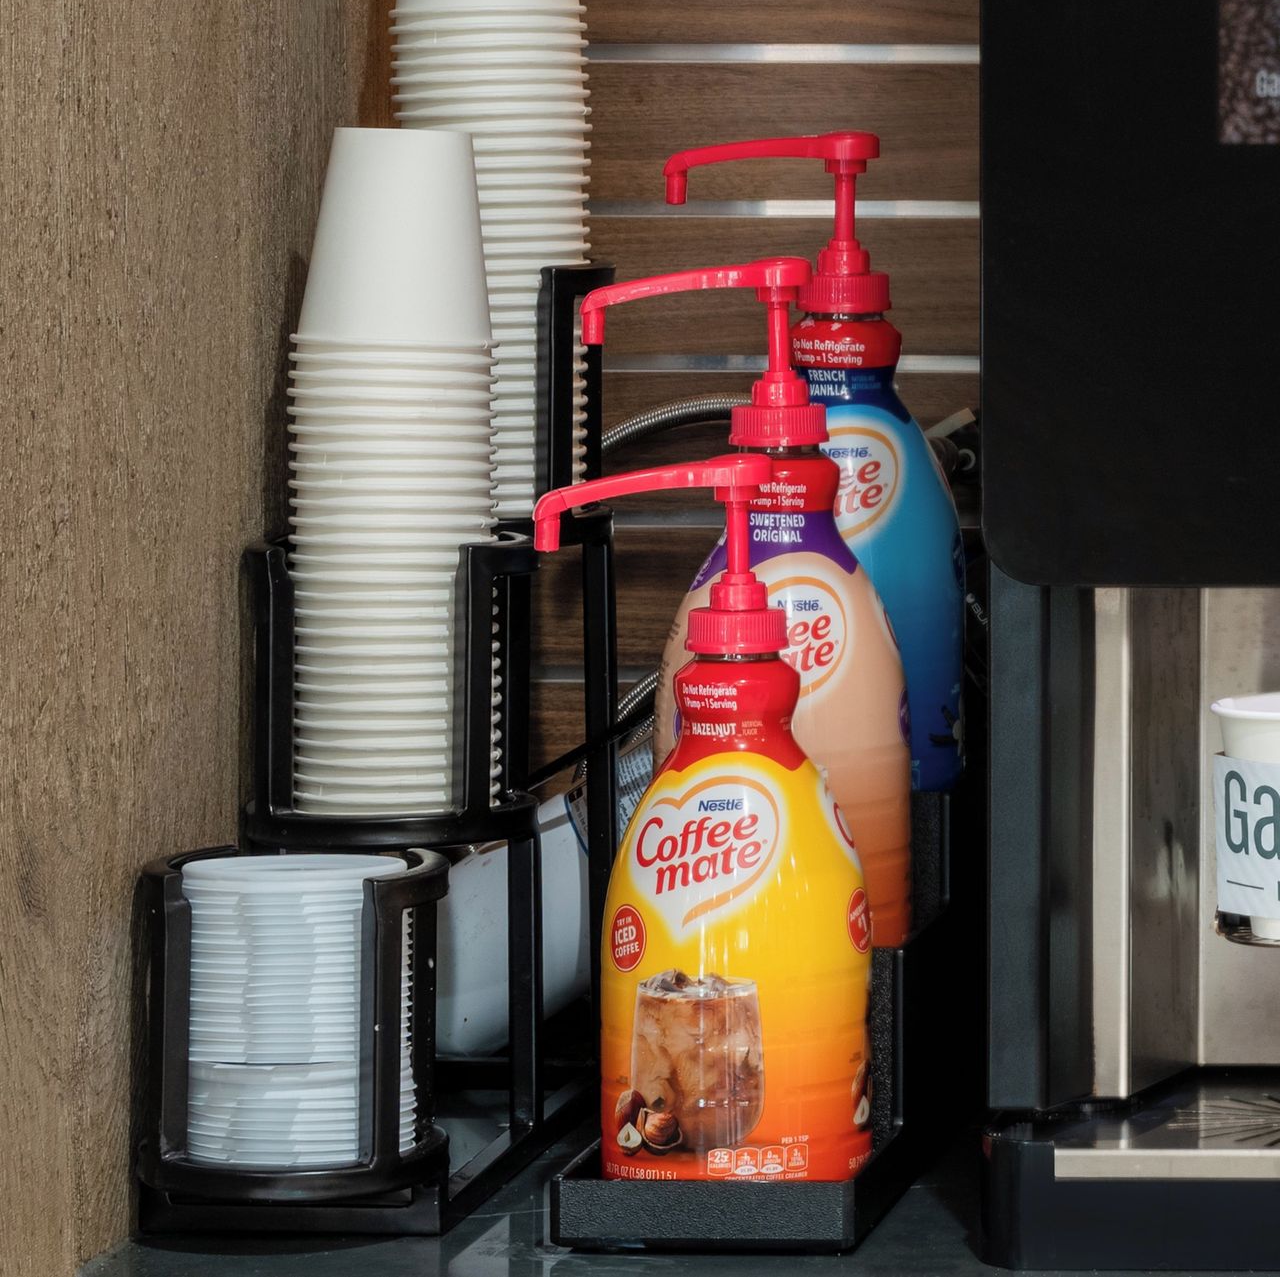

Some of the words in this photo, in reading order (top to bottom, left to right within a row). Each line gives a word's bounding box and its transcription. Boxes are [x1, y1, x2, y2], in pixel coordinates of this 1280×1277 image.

[801, 339, 813, 349] Not
[814, 340, 865, 353] Refrigerate
[828, 353, 862, 365] Serving
[808, 370, 845, 381] FRENCH
[809, 384, 847, 396] VANILLA
[772, 482, 806, 496] Refrigerate
[781, 497, 804, 508] Serving
[750, 513, 805, 528] SWEETENED
[753, 527, 802, 543] ORIGINAL
[689, 684, 698, 695] Not
[699, 684, 736, 698] Refrigerate
[710, 699, 737, 711] Serving
[692, 723, 736, 736] HAZELNUT
[698, 798, 744, 812] Nestlé
[636, 814, 759, 867] Coffee
[655, 841, 761, 895] mate
[615, 925, 636, 945] ICED
[615, 942, 639, 958] COFFEE
